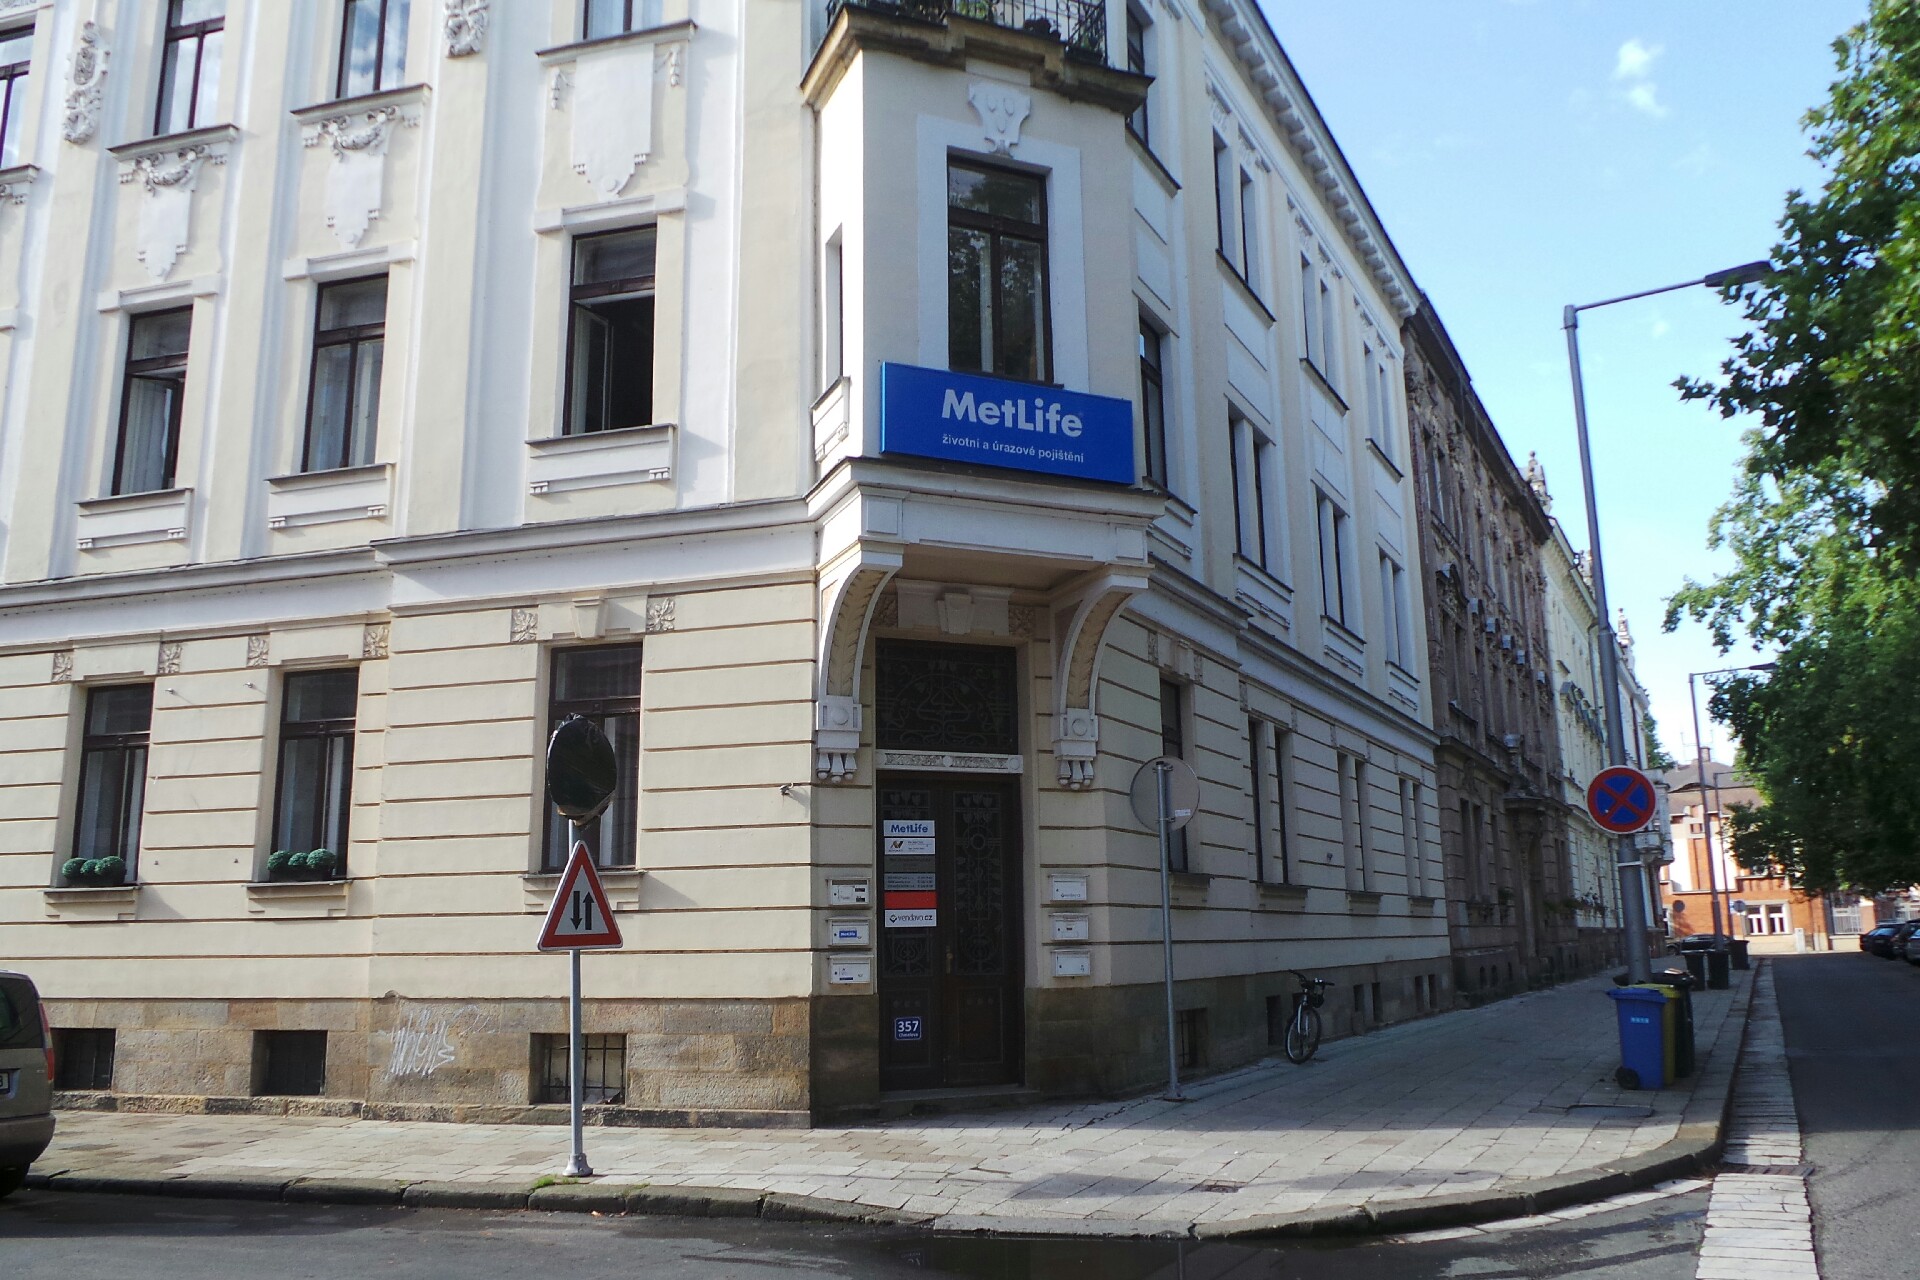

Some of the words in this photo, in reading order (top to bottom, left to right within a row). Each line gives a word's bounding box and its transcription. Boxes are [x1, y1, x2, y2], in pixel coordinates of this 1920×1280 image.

[941, 388, 1083, 438] MetLife
[942, 433, 980, 449] životní
[982, 441, 989, 450] a
[992, 440, 1036, 456] úrazové
[1038, 448, 1084, 463] pojištění
[890, 823, 929, 833] MetLife
[897, 1020, 919, 1032] 357
